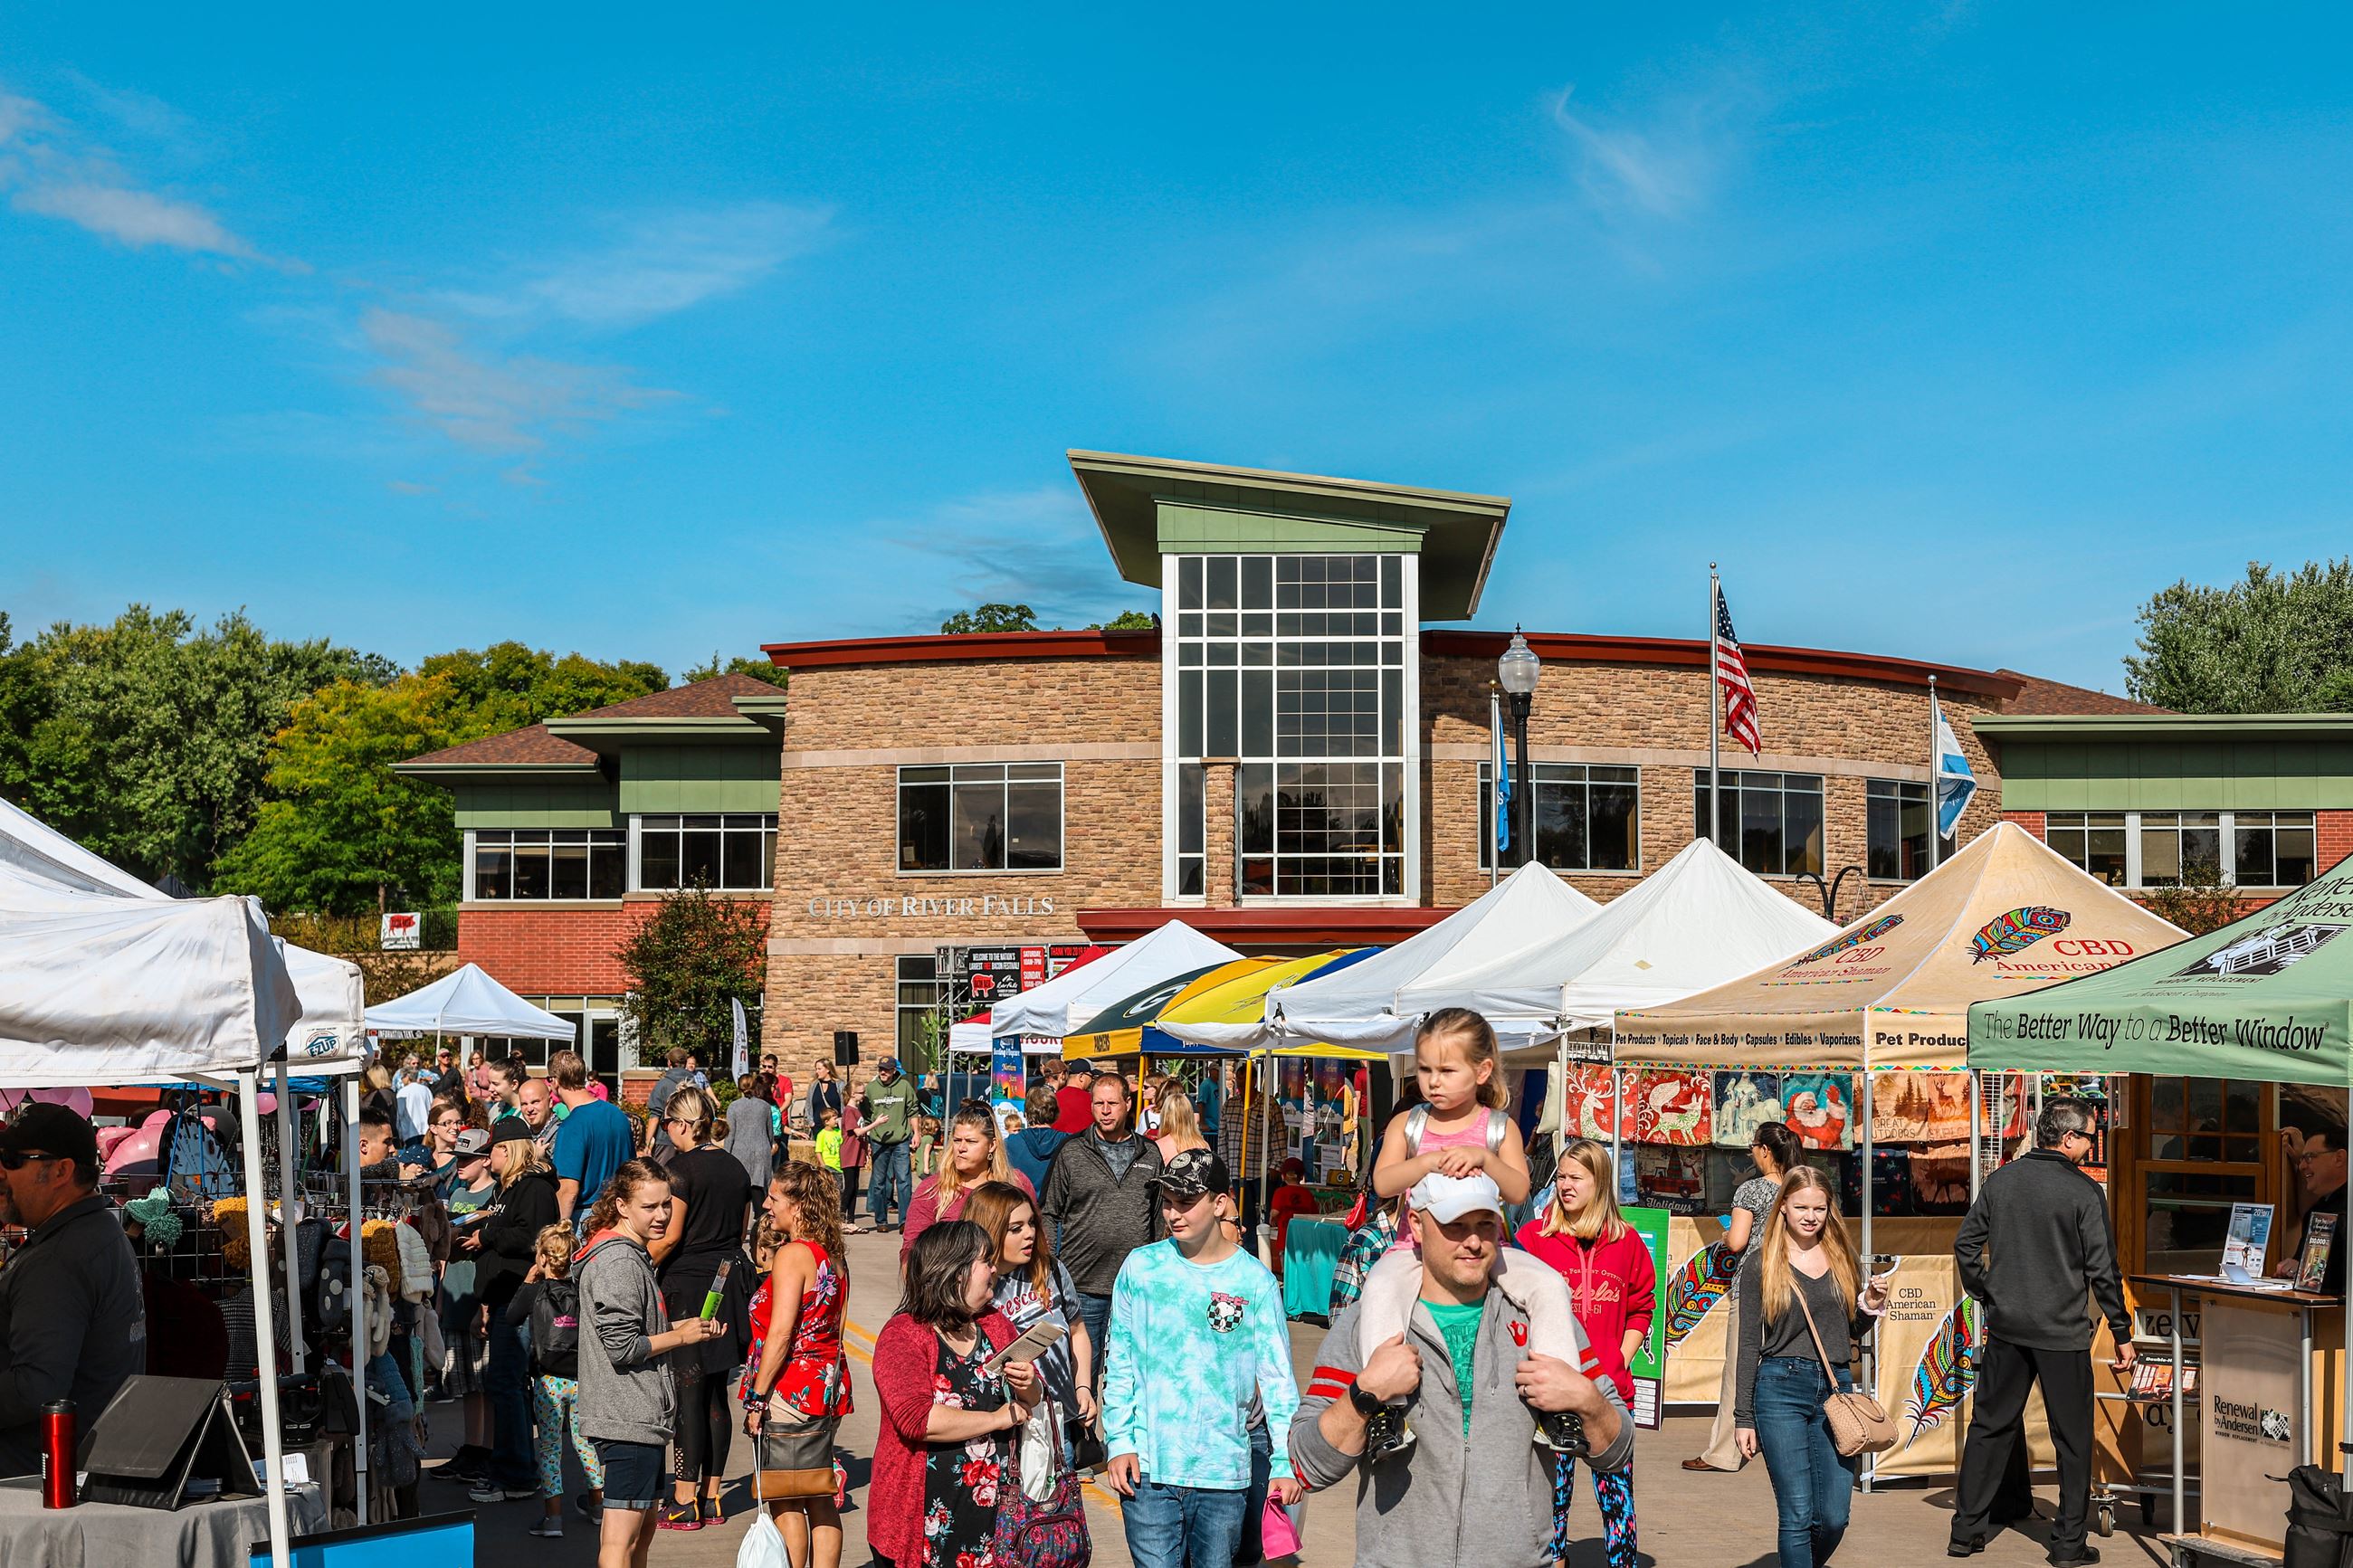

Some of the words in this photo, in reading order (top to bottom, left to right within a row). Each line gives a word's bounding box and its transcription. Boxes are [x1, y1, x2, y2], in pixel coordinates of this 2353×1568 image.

[2282, 877, 2353, 907] Rene
[866, 898, 897, 917] OF
[1835, 946, 1885, 964] CBD
[2053, 939, 2134, 956] CBD
[1777, 968, 1839, 978] American
[1837, 966, 1891, 977] Shaman
[1996, 961, 2113, 972] American
[1984, 1011, 2013, 1039] The
[2016, 1012, 2072, 1040] Better
[2078, 1012, 2121, 1050] Way
[2124, 1012, 2145, 1041] to
[2148, 1017, 2164, 1041] a
[2166, 1014, 2228, 1046] Better
[1615, 1033, 1627, 1044] Pet
[1628, 1033, 1656, 1045] Products
[1662, 1033, 1690, 1047] Topicals
[1695, 1033, 1711, 1045] Face
[1713, 1033, 1720, 1044] &
[1720, 1033, 1739, 1048] Body
[1745, 1032, 1777, 1047] Capsules
[1785, 1032, 1812, 1045] Edibles
[1819, 1032, 1861, 1048] Vaporizers
[1875, 1032, 1904, 1046] Pet
[1873, 1118, 1905, 1128] GREAT
[1645, 1197, 1693, 1213] Holidays
[1899, 1288, 1923, 1298] CBD
[1886, 1299, 1937, 1309] American
[2214, 1394, 2258, 1421] Renewal
[2232, 1433, 2258, 1443] REPLACEMENT
